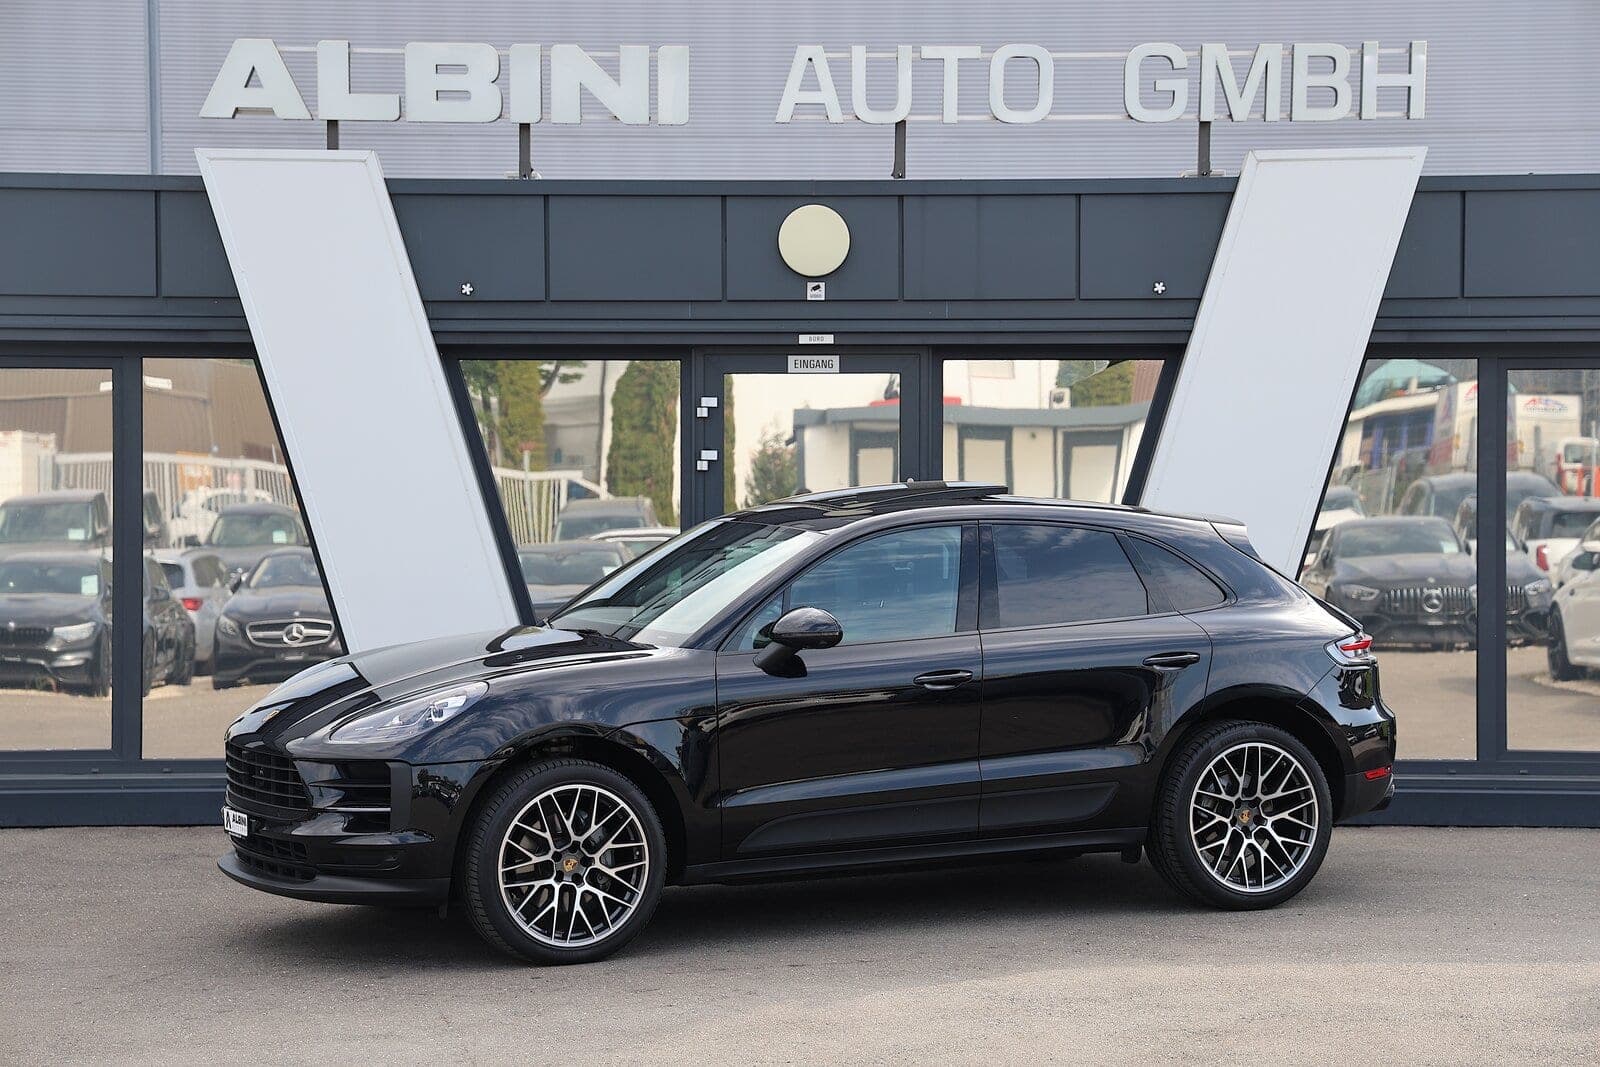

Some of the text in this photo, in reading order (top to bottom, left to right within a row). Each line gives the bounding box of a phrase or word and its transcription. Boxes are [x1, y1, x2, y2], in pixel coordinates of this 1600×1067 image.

[200, 38, 1428, 125] ALBINI AUTO GMBH
[794, 359, 834, 369] EINGANG
